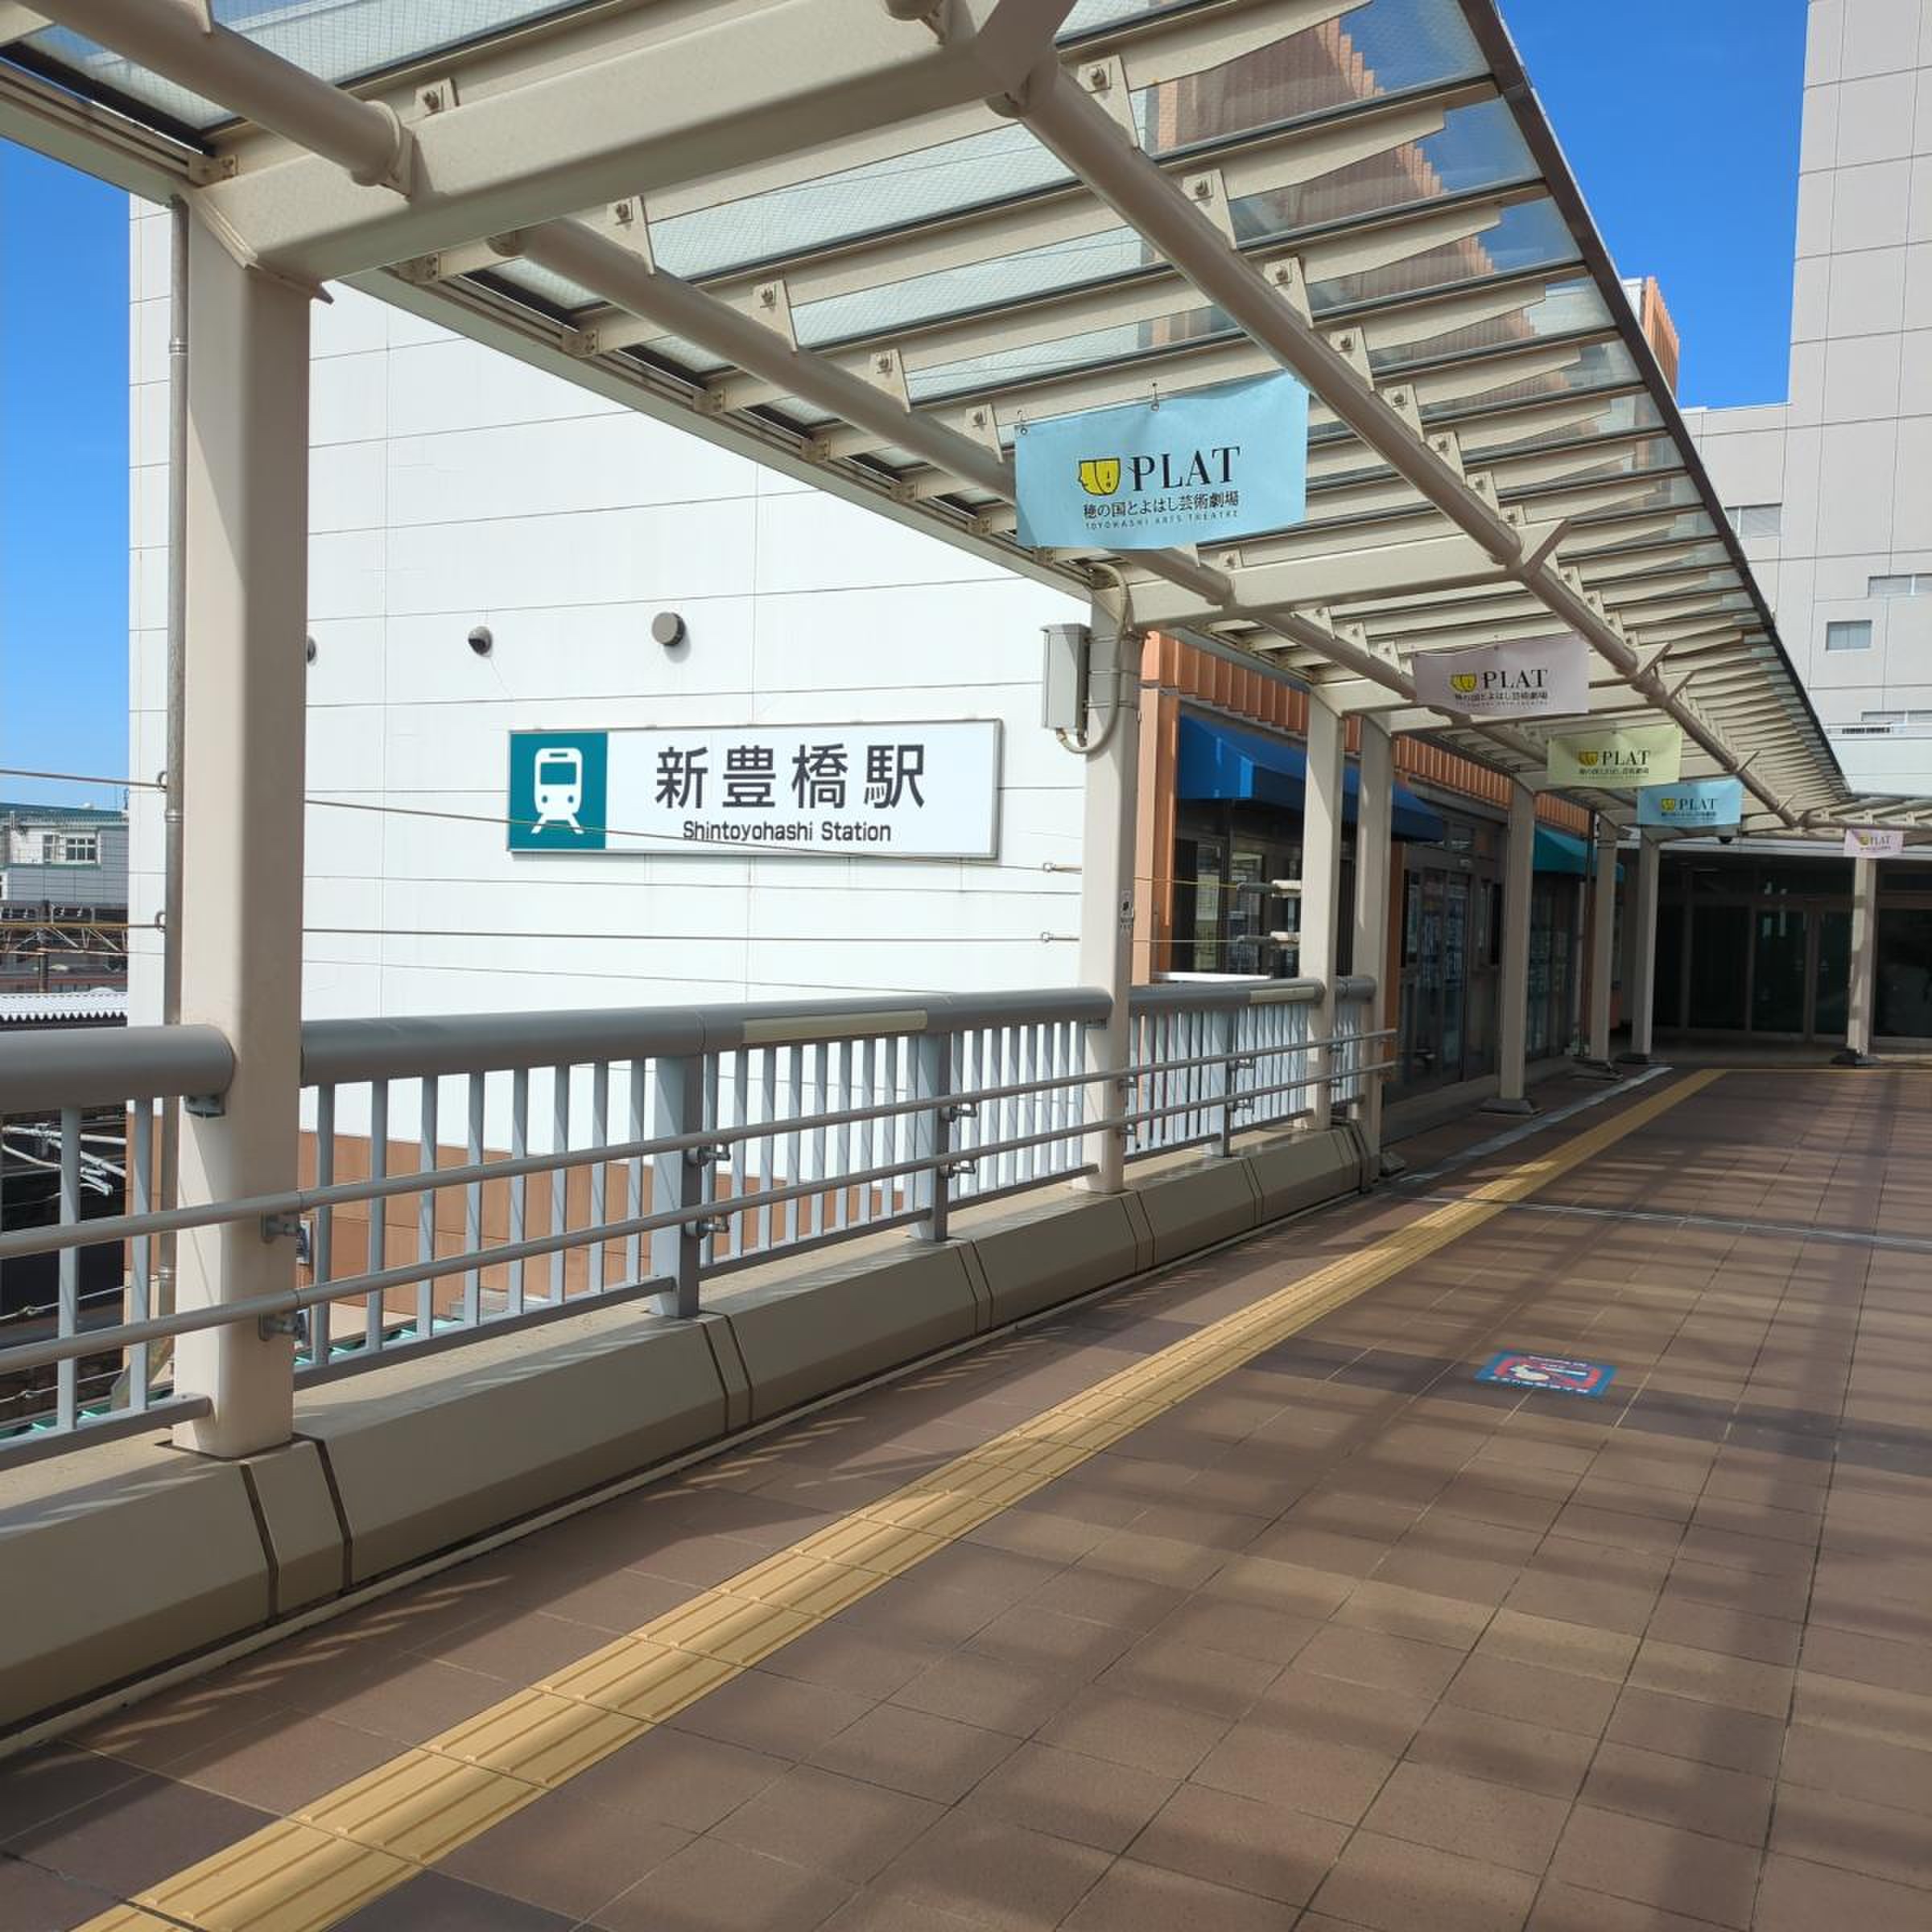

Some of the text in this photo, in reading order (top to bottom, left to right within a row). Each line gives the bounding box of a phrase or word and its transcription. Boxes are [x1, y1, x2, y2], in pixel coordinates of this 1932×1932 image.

[1130, 446, 1241, 491] PLAT
[1483, 669, 1548, 689] PLAT
[1602, 749, 1650, 766] PLAT
[654, 743, 925, 809] 新豊橋駅
[683, 820, 891, 841] Shintoyohashi Station
